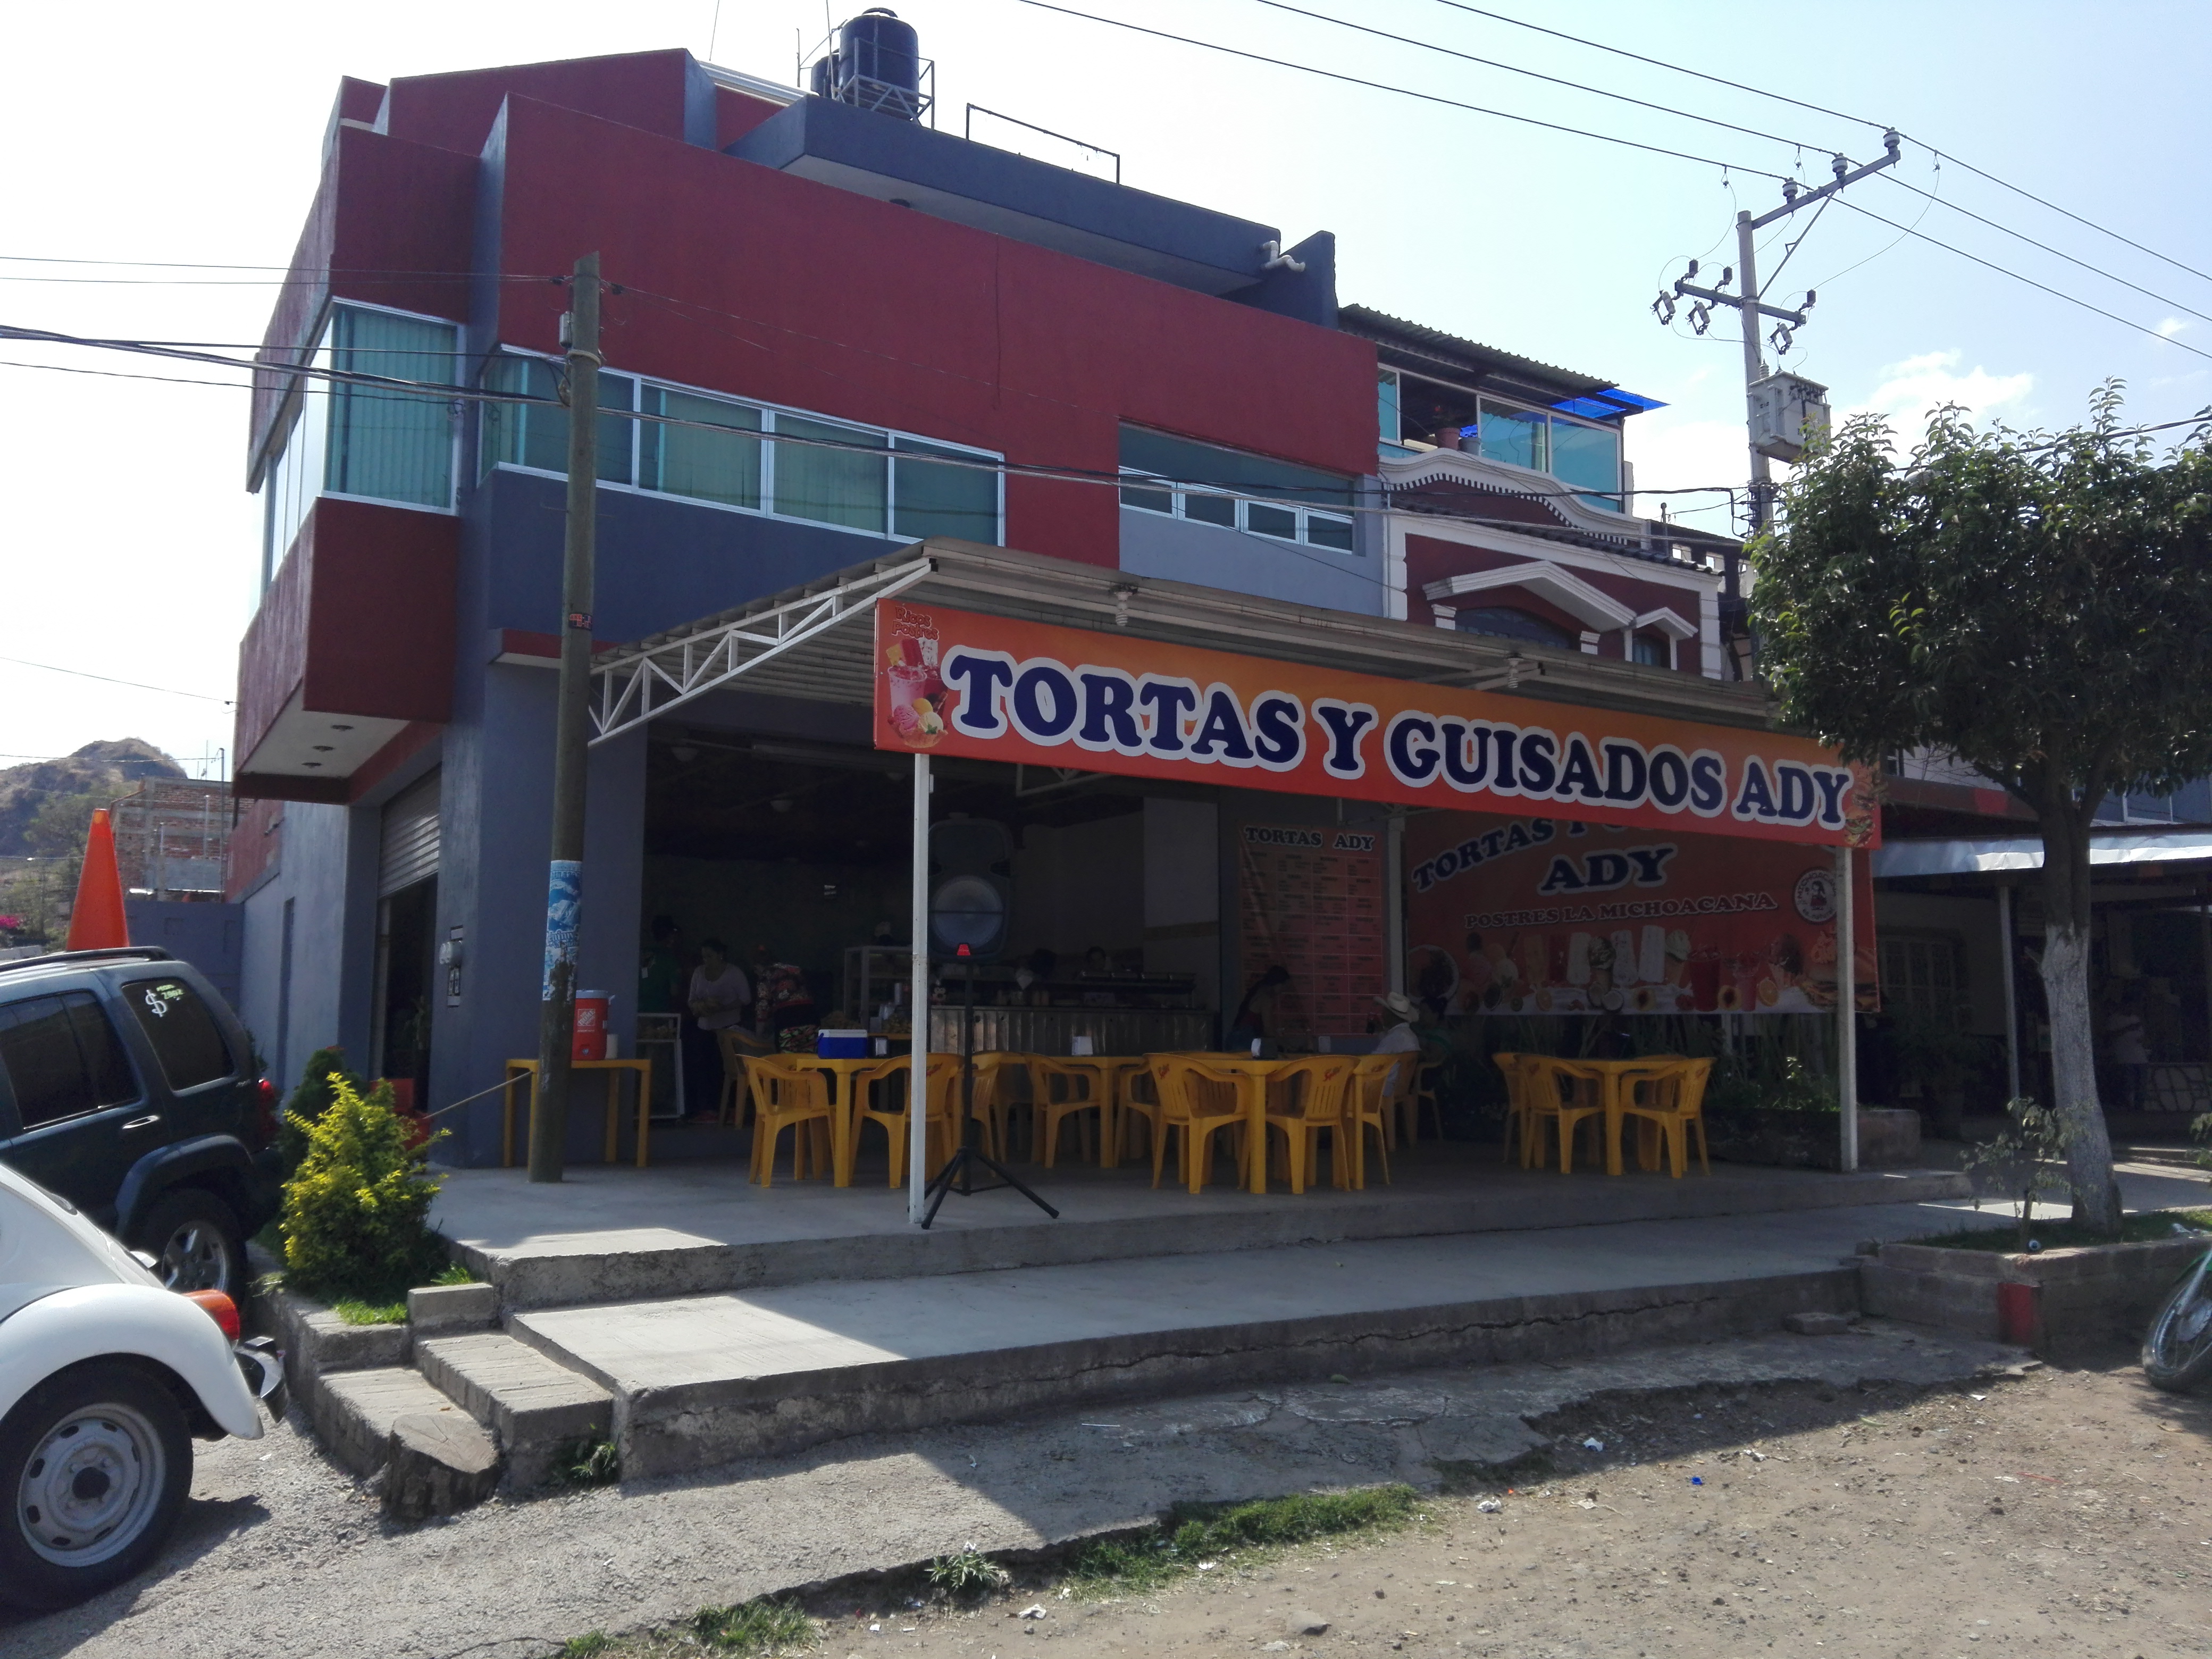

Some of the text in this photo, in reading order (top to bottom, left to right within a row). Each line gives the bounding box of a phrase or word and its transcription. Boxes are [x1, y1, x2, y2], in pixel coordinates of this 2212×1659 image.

[891, 620, 940, 641] Postres
[895, 607, 931, 627] Ricos
[949, 653, 1850, 825] TORTAS Y GUISADOS ADY
[1245, 827, 1375, 850] TORTAS ADY
[1413, 817, 1554, 890] TORTAS
[1540, 848, 1674, 891] ADY
[1465, 892, 1777, 929] POSTRES LA MICHOACANA
